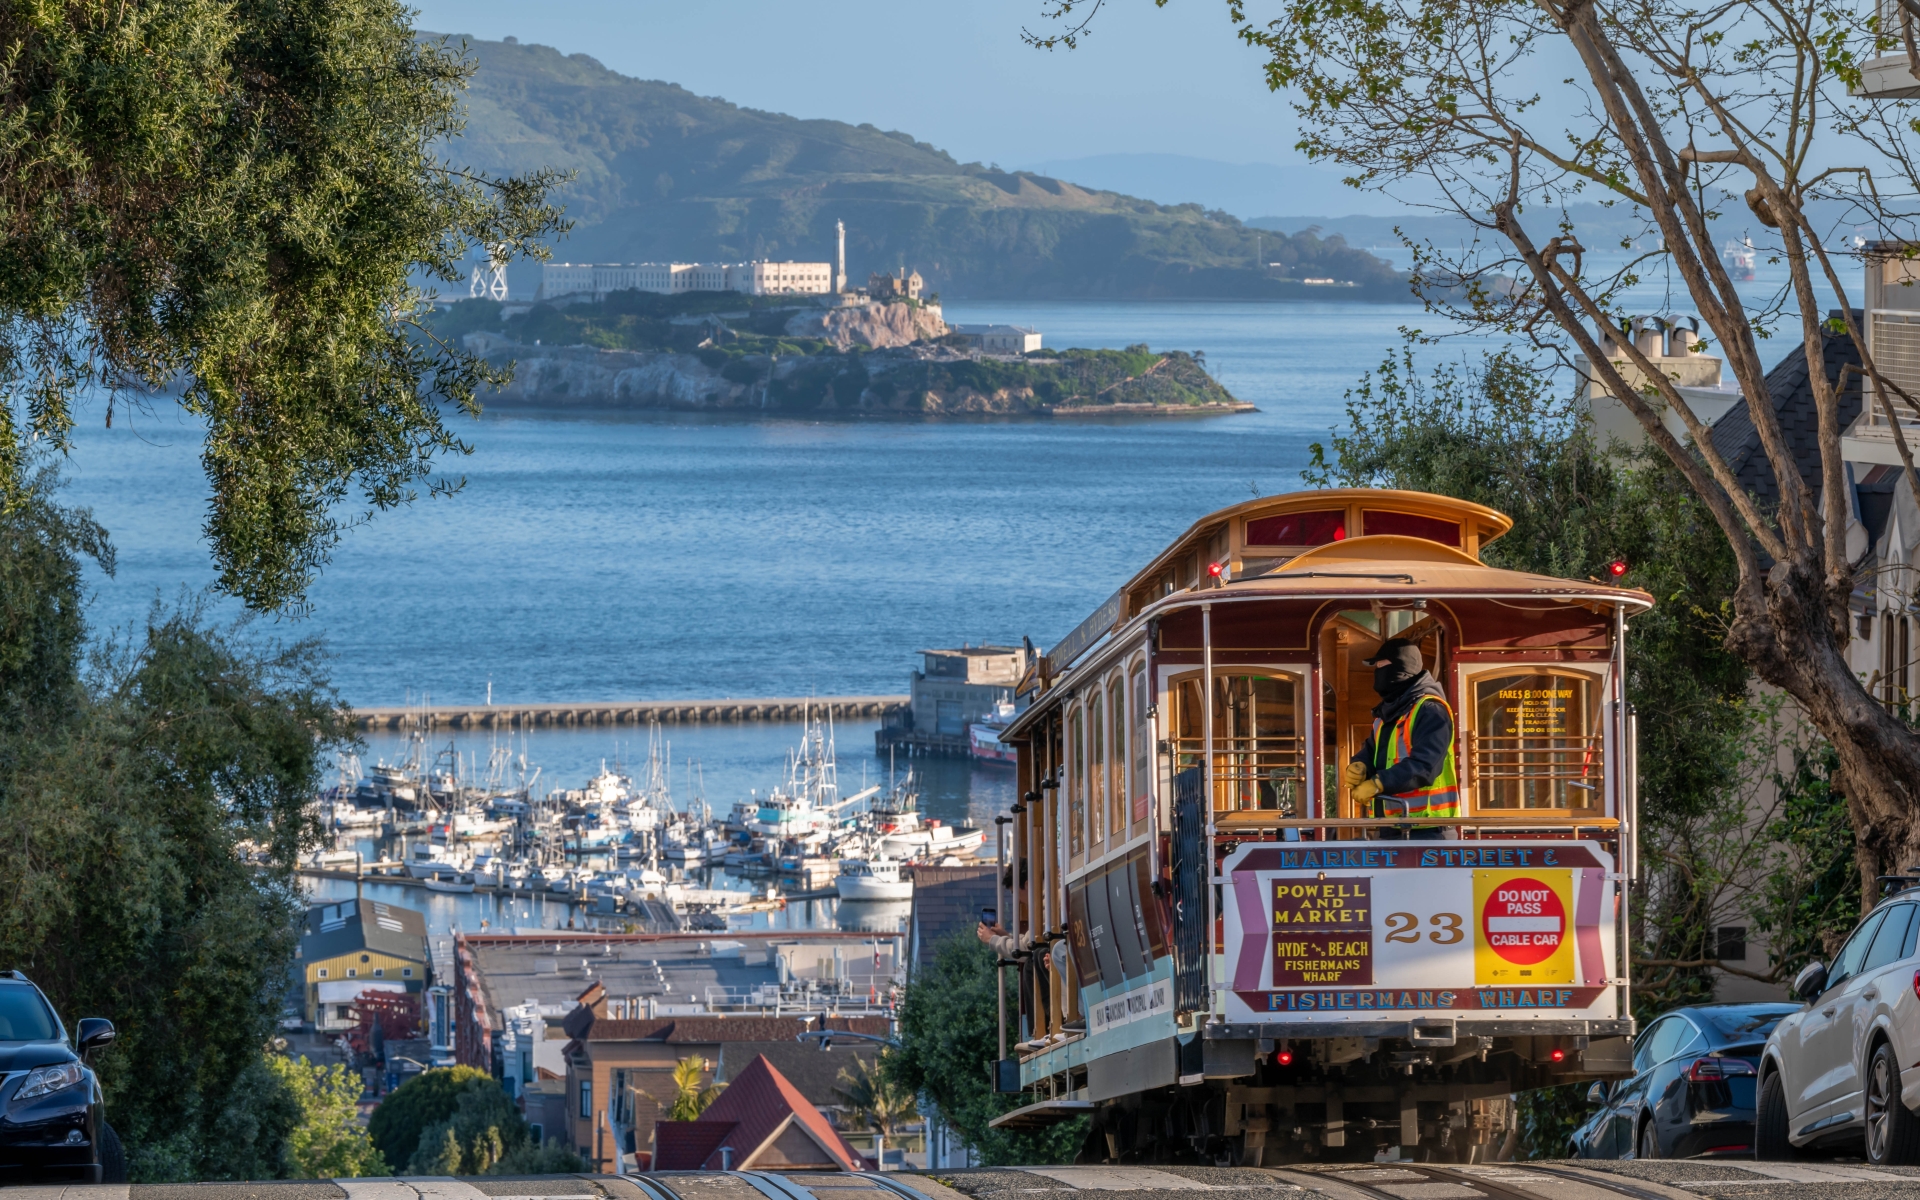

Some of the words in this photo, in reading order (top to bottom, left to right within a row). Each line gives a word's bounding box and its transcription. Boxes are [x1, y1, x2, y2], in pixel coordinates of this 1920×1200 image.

[1050, 636, 1077, 672] POWELL
[1089, 606, 1108, 638] HYDE
[1542, 690, 1557, 698] ONE
[1558, 690, 1573, 698] WAY
[1281, 850, 1398, 868] MARKET
[1421, 849, 1533, 866] STREET
[1277, 885, 1366, 898] POWELL
[1498, 890, 1519, 902] DO
[1521, 890, 1549, 902] NOT
[1300, 899, 1344, 909] AND
[1507, 903, 1541, 914] PASS
[1275, 909, 1368, 923] MARKET
[1384, 911, 1465, 945] 23
[1491, 934, 1530, 946] CABLE
[1533, 934, 1558, 946] CAR
[1277, 942, 1308, 957] HYDE
[1311, 943, 1326, 957] AND
[1328, 941, 1368, 957] BEACH
[1284, 960, 1360, 971] FISHERMANS
[1303, 972, 1342, 982] WHARF
[1268, 991, 1454, 1010] FISHERMANS
[1479, 990, 1573, 1008] WHARF
